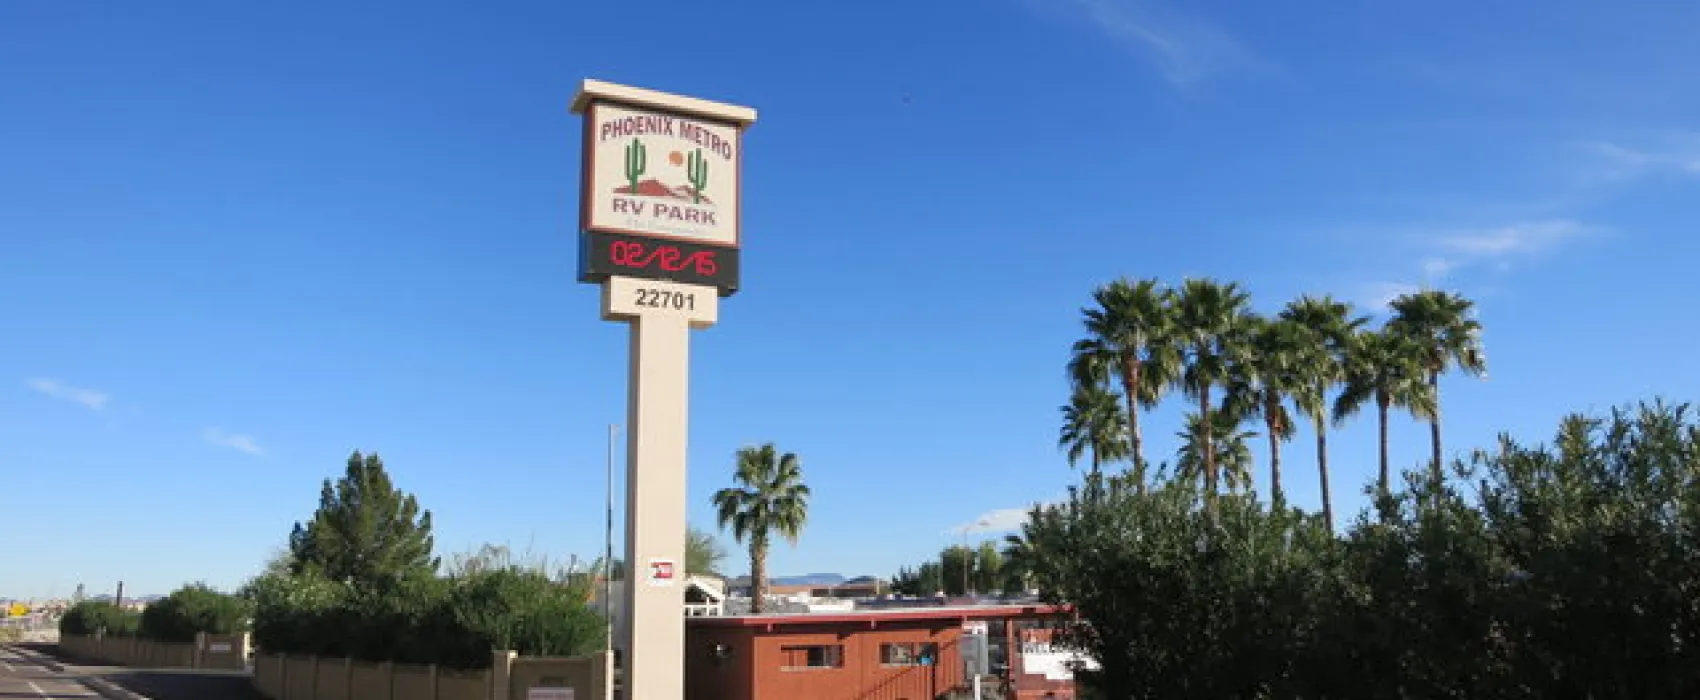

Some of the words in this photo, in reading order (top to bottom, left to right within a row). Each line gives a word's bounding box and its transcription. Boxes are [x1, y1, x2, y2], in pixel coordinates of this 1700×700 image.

[602, 115, 673, 140] PHOENIX
[680, 121, 732, 160] METRO
[612, 198, 644, 215] RV
[653, 203, 717, 225] PARK
[610, 241, 718, 276] 02/12/15
[635, 289, 695, 310] 22701
